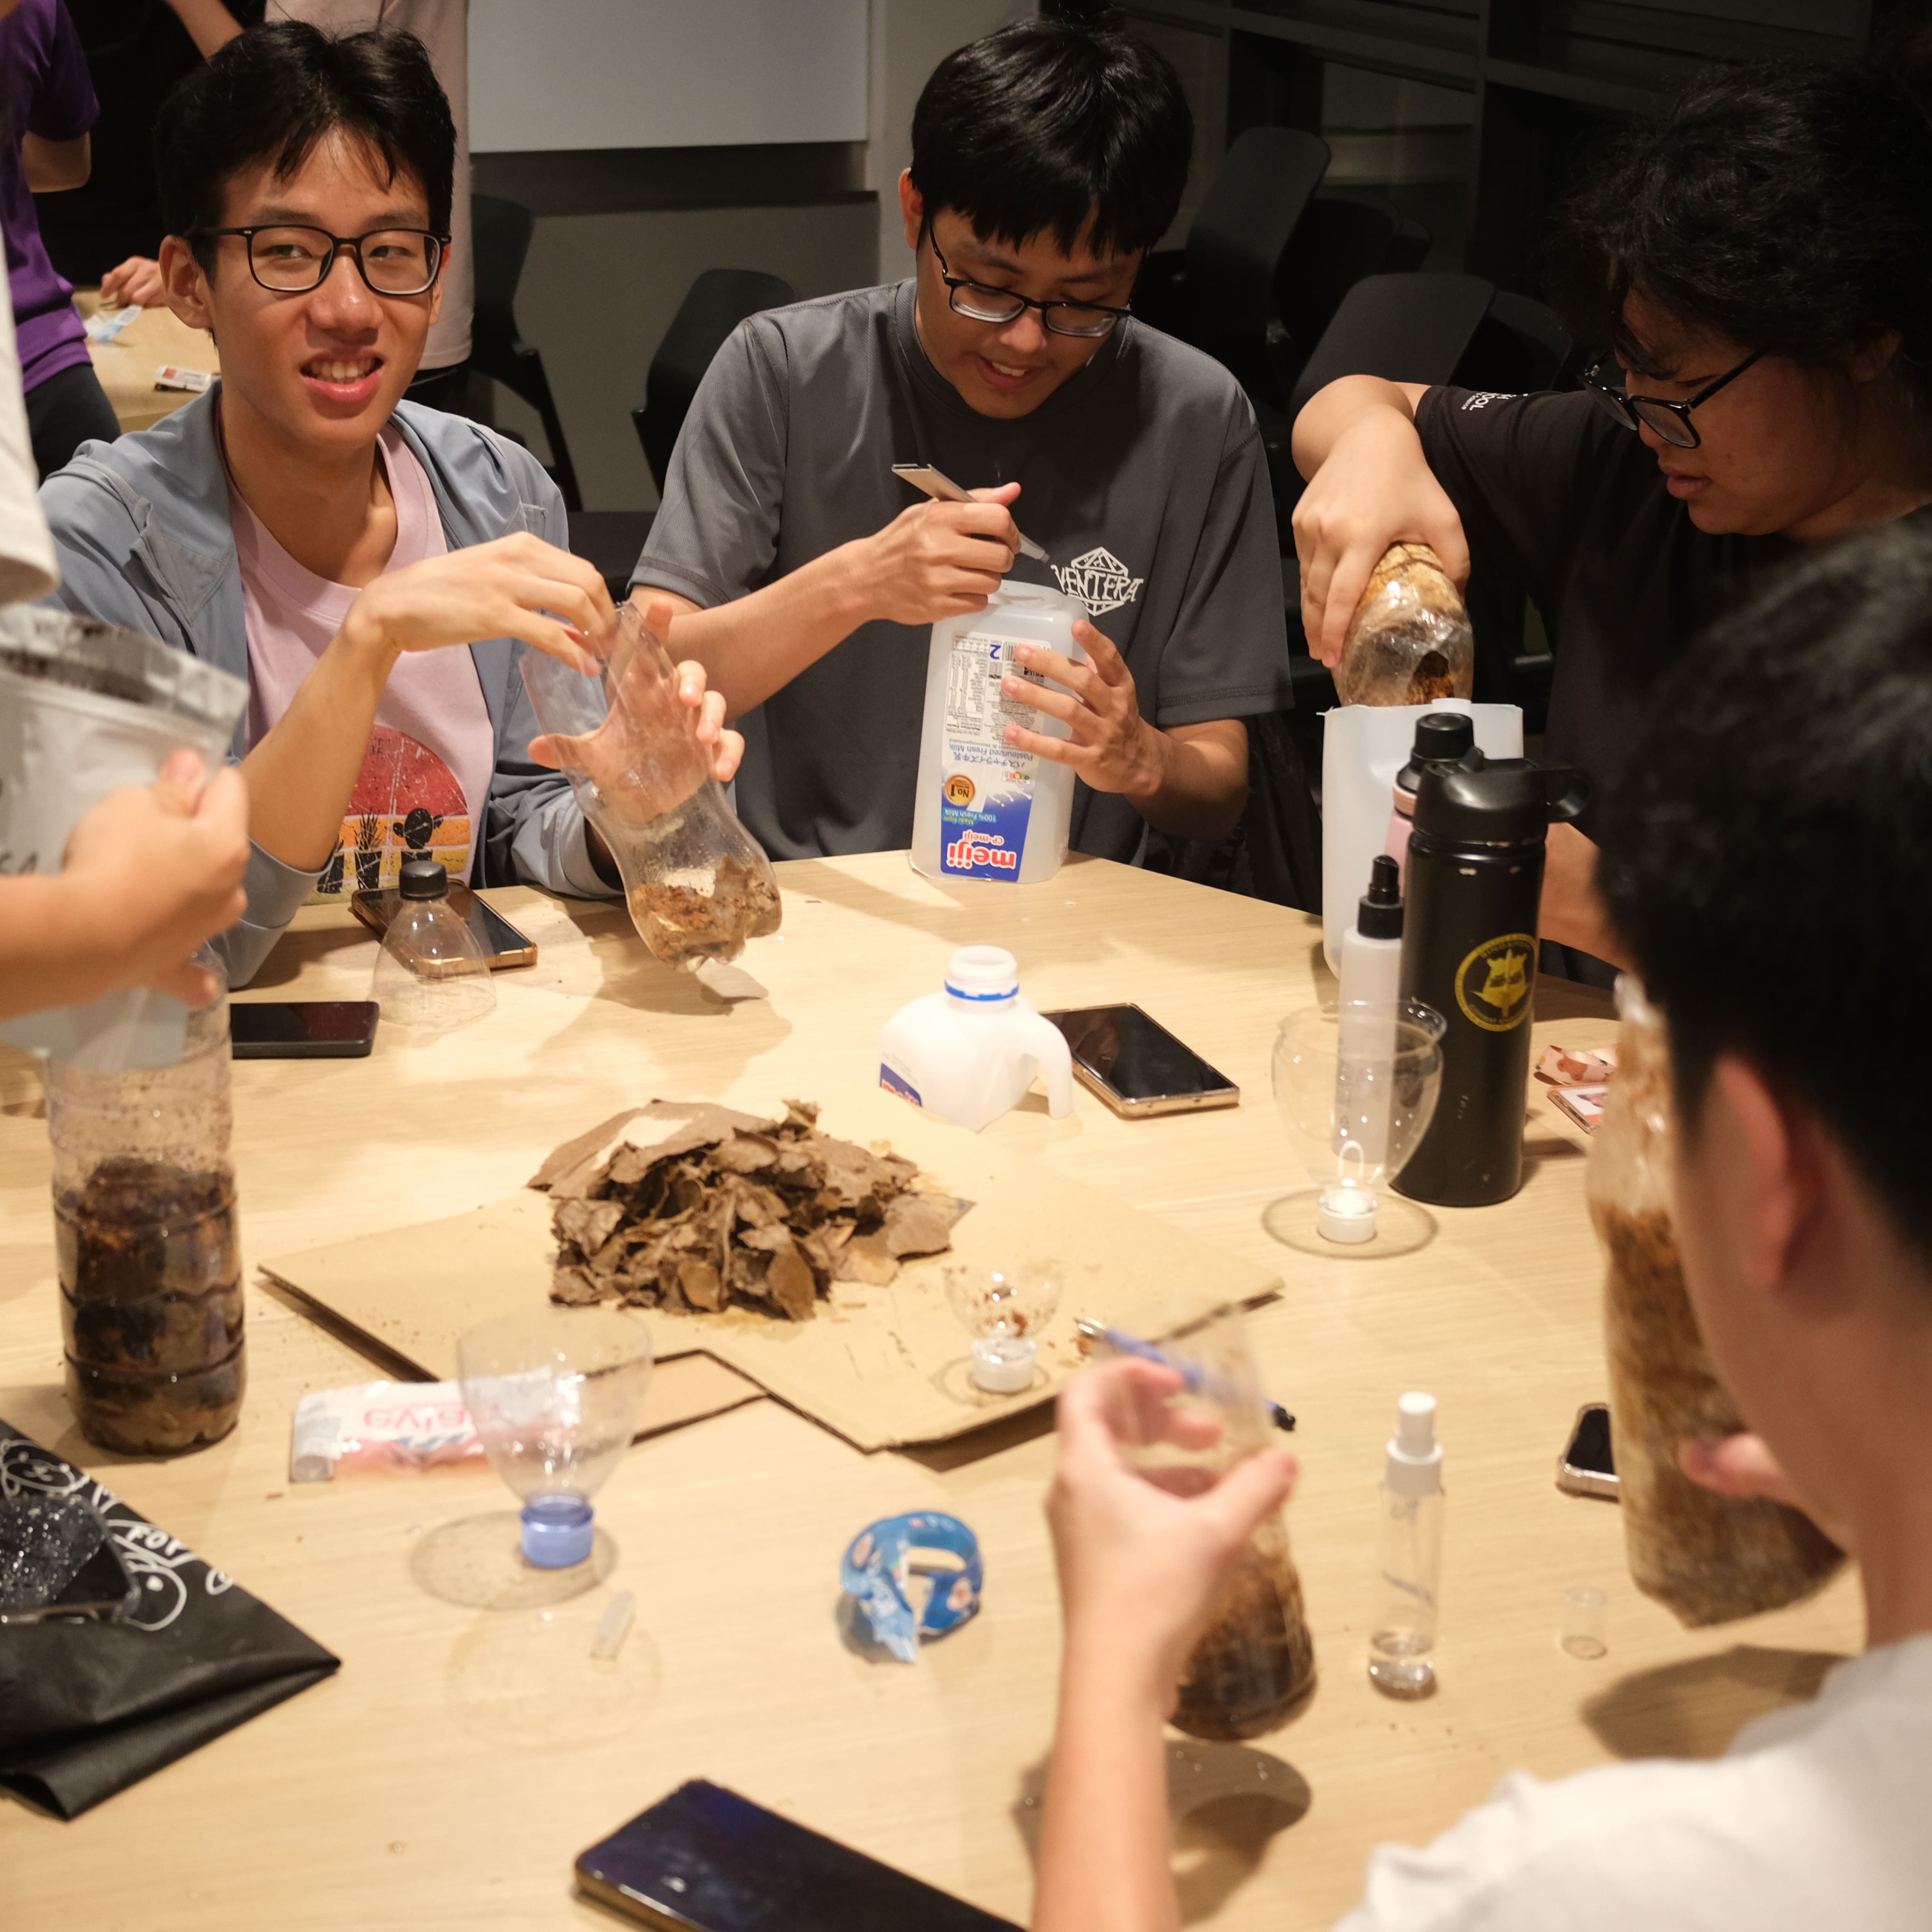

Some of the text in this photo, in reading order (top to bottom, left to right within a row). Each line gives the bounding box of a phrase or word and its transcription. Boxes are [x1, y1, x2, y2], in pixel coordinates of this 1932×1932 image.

[990, 644, 1001, 659] 2
[949, 744, 1033, 762] Pasteurized Fresh Milk
[953, 752, 1025, 769] パスチャライズ牛乳
[945, 809, 995, 822] 100% Fresh Milk
[963, 831, 1004, 845] CP-meiji
[947, 841, 1016, 868] meiji
